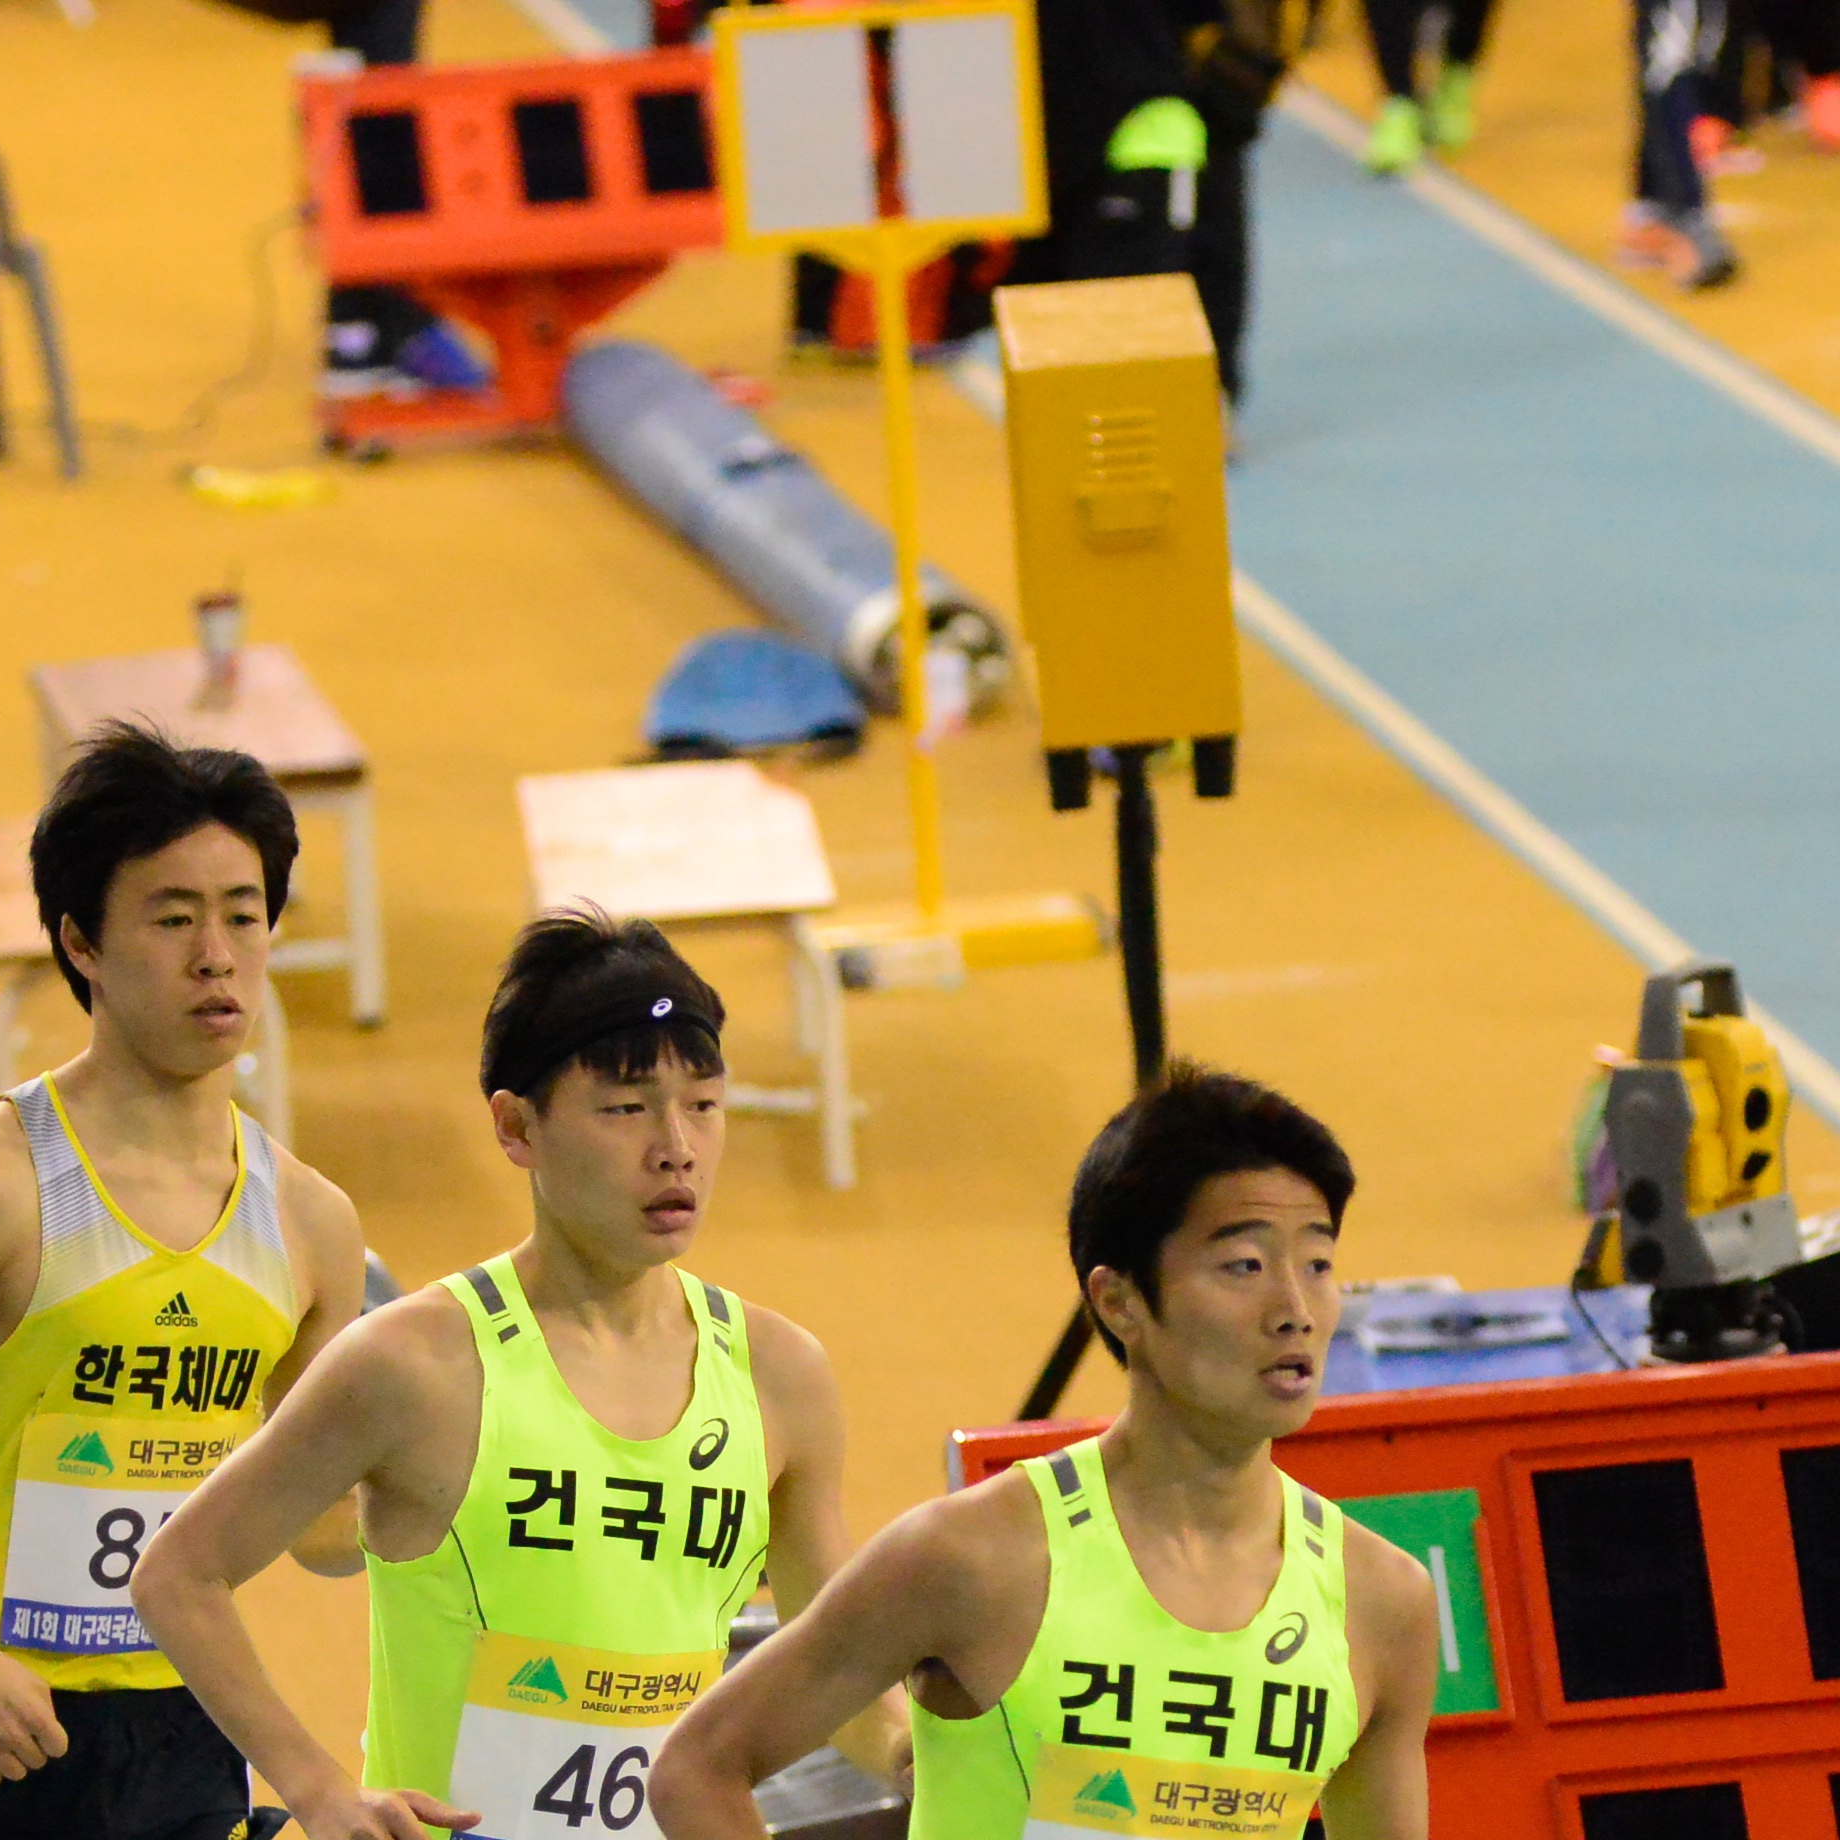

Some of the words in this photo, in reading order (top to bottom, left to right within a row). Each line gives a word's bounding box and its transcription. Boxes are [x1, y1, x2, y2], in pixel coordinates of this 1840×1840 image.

[155, 1313, 197, 1327] adidas
[73, 1343, 260, 1413] 한국체대
[57, 1463, 96, 1476] DAEGU
[127, 1468, 159, 1478] DAEGU
[505, 1467, 747, 1569] 건국대
[89, 1507, 172, 1590] 8
[12, 1607, 59, 1643] 제1회
[508, 1689, 548, 1704] DAEGU
[585, 1669, 702, 1701] 대구광역시
[581, 1700, 617, 1713] DAEGU
[619, 1703, 675, 1715] METROPOLITAN
[1059, 1660, 1329, 1773] 건국대
[533, 1744, 650, 1831] 46
[1154, 1781, 1289, 1818] 대구광역시
[1150, 1814, 1185, 1827] DAEGU
